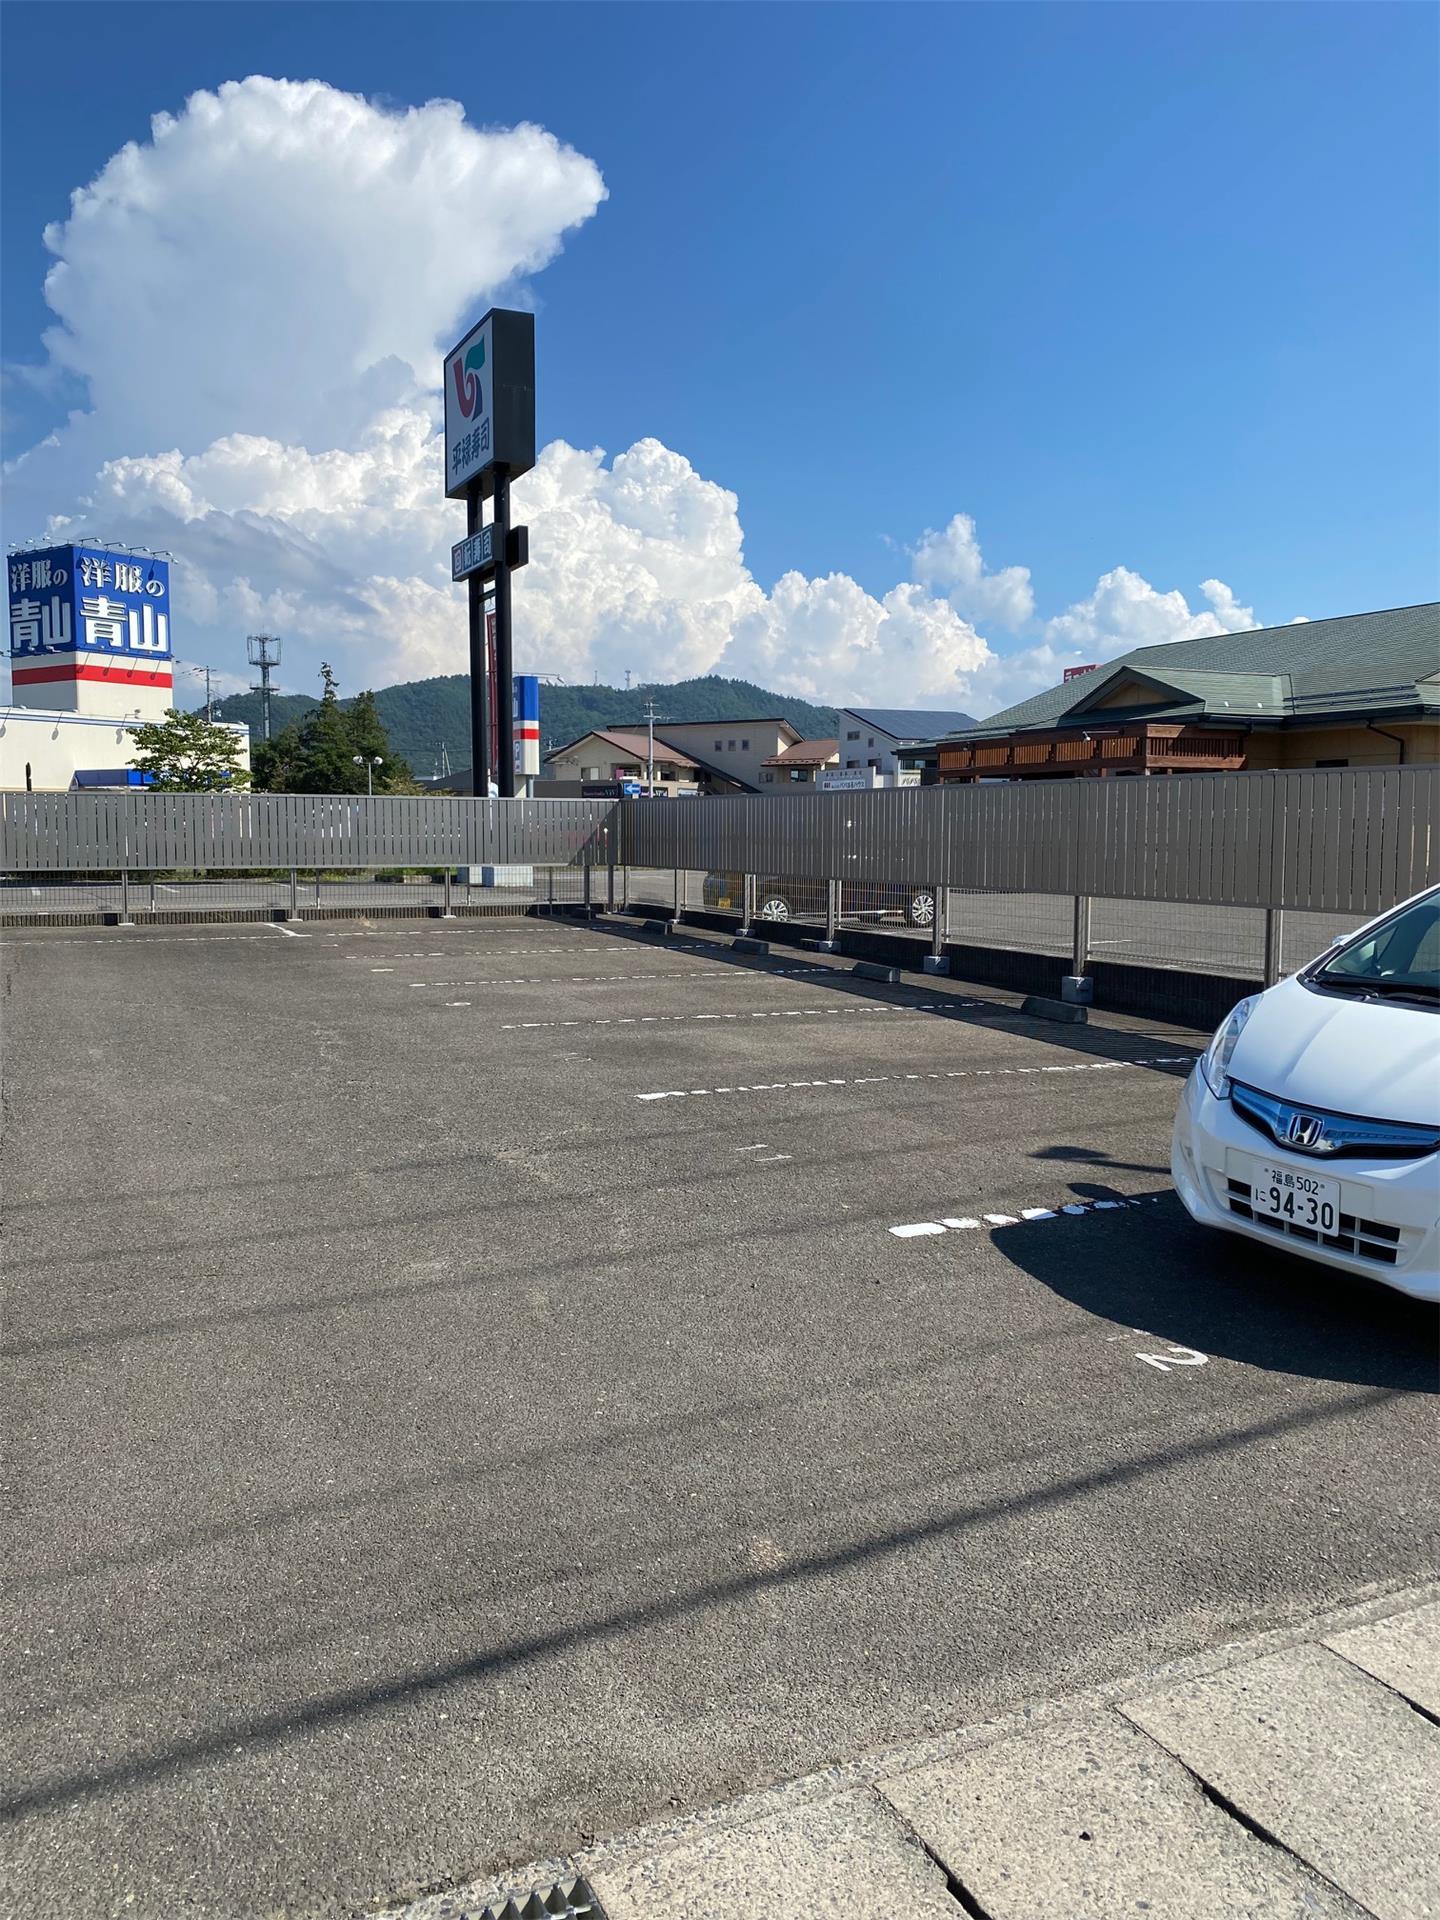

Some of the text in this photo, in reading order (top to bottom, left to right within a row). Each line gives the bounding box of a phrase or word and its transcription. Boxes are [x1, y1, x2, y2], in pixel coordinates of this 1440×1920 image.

[452, 419, 490, 474] 平禄寿司
[11, 559, 68, 593] 洋服の
[81, 557, 166, 597] 洋服の
[10, 596, 72, 649] 青山
[80, 595, 169, 652] 青山
[1269, 1186, 1334, 1230] 94-30
[1135, 1347, 1209, 1372] 2
